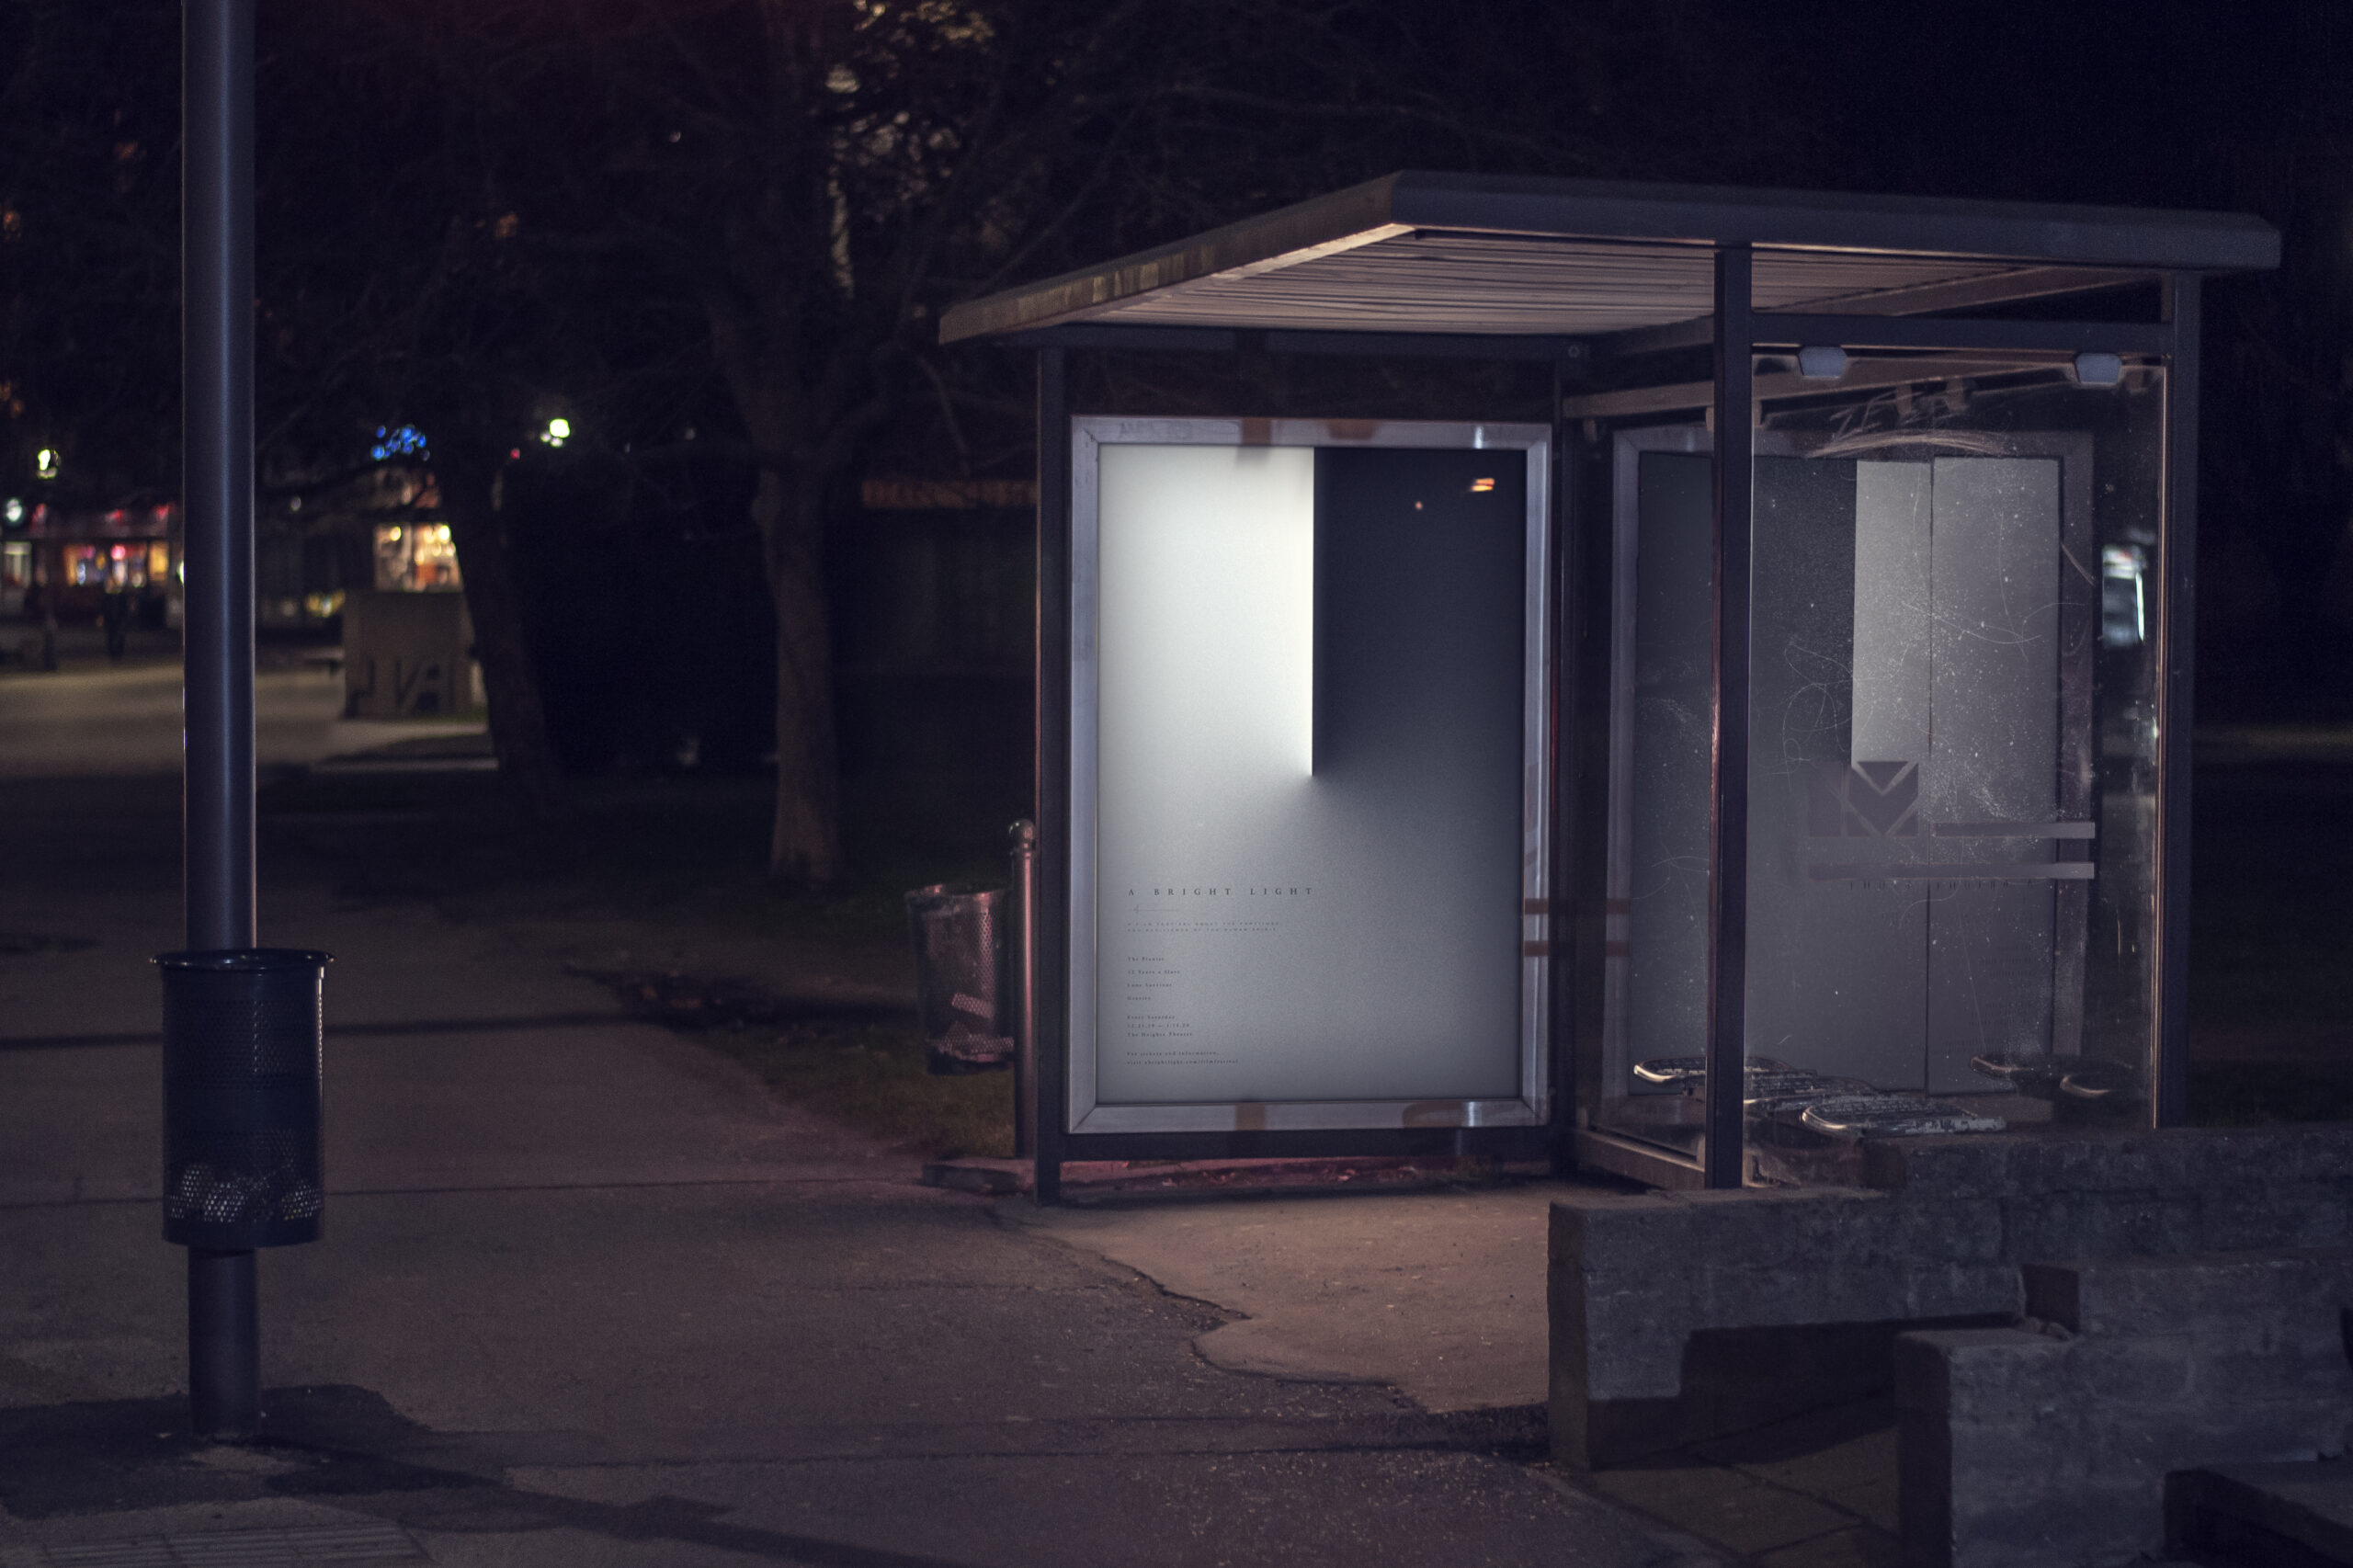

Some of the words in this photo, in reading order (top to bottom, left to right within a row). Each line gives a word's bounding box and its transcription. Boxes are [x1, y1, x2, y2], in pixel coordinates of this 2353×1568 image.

[1128, 888, 1135, 896] A
[1154, 888, 1232, 896] BRIGHT
[1250, 887, 1313, 896] LIGHT
